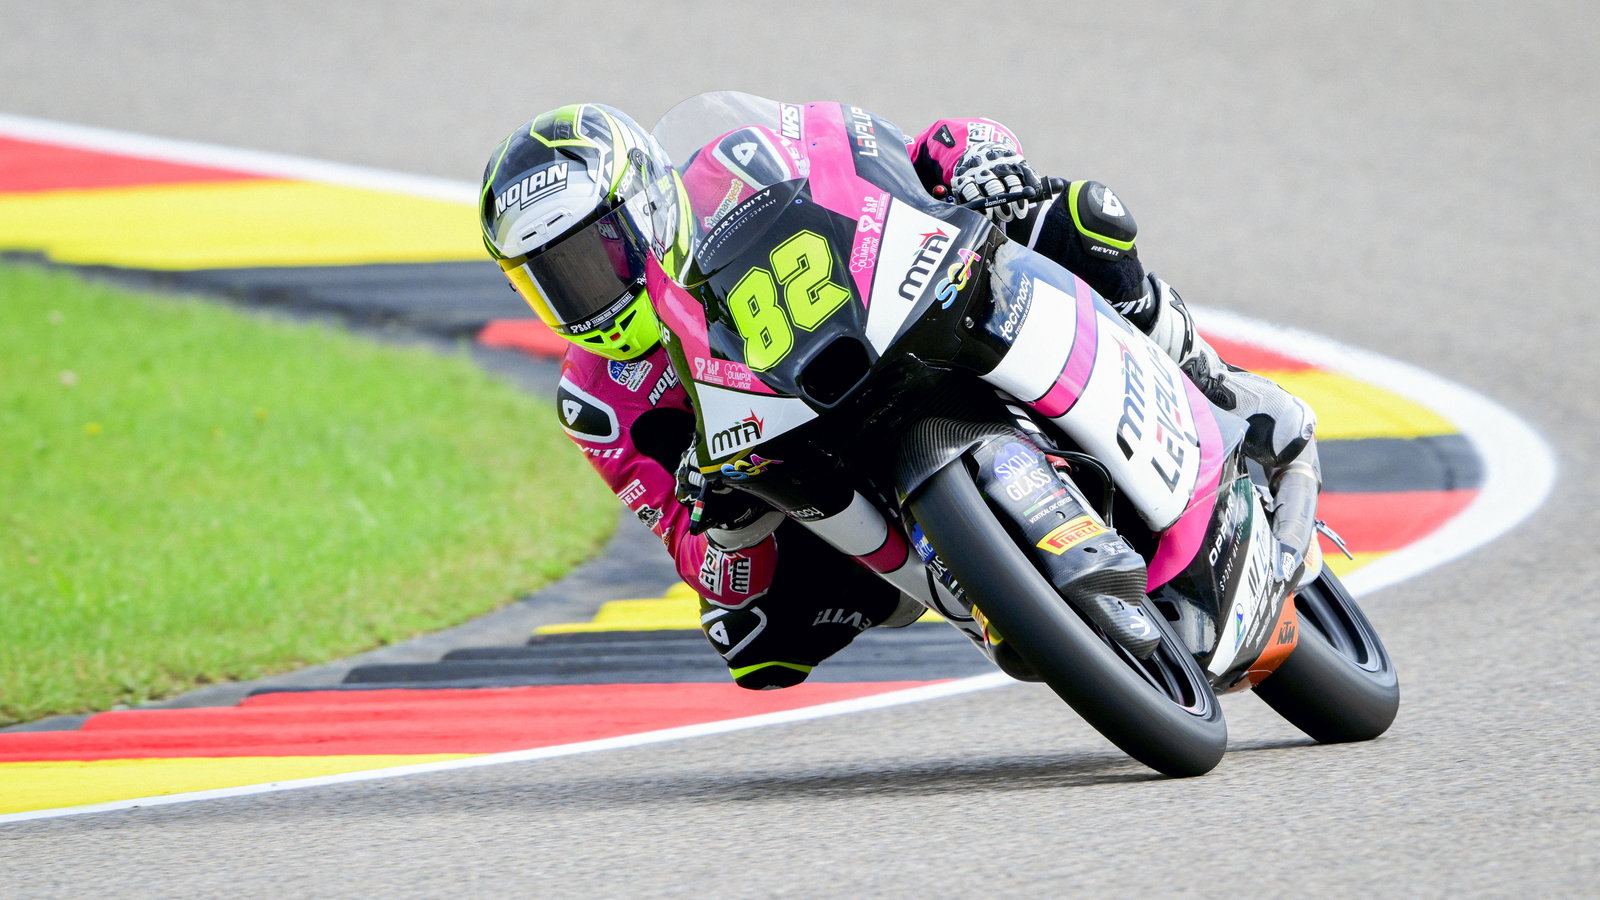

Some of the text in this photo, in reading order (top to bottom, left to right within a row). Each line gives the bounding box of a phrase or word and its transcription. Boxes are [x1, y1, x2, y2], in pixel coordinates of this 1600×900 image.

[495, 162, 568, 218] NOLAN
[697, 189, 771, 260] OPPORTUNITY
[898, 234, 950, 302] MTA
[727, 229, 850, 372] 82
[648, 364, 678, 406] NOL
[712, 421, 761, 454] MTA
[995, 452, 1038, 480] SKILL
[1006, 468, 1052, 501] GLASS
[1046, 521, 1100, 549] PIRELLI
[731, 558, 750, 593] MTA
[1220, 558, 1233, 592] SPORT
[1277, 621, 1296, 645] KTM
